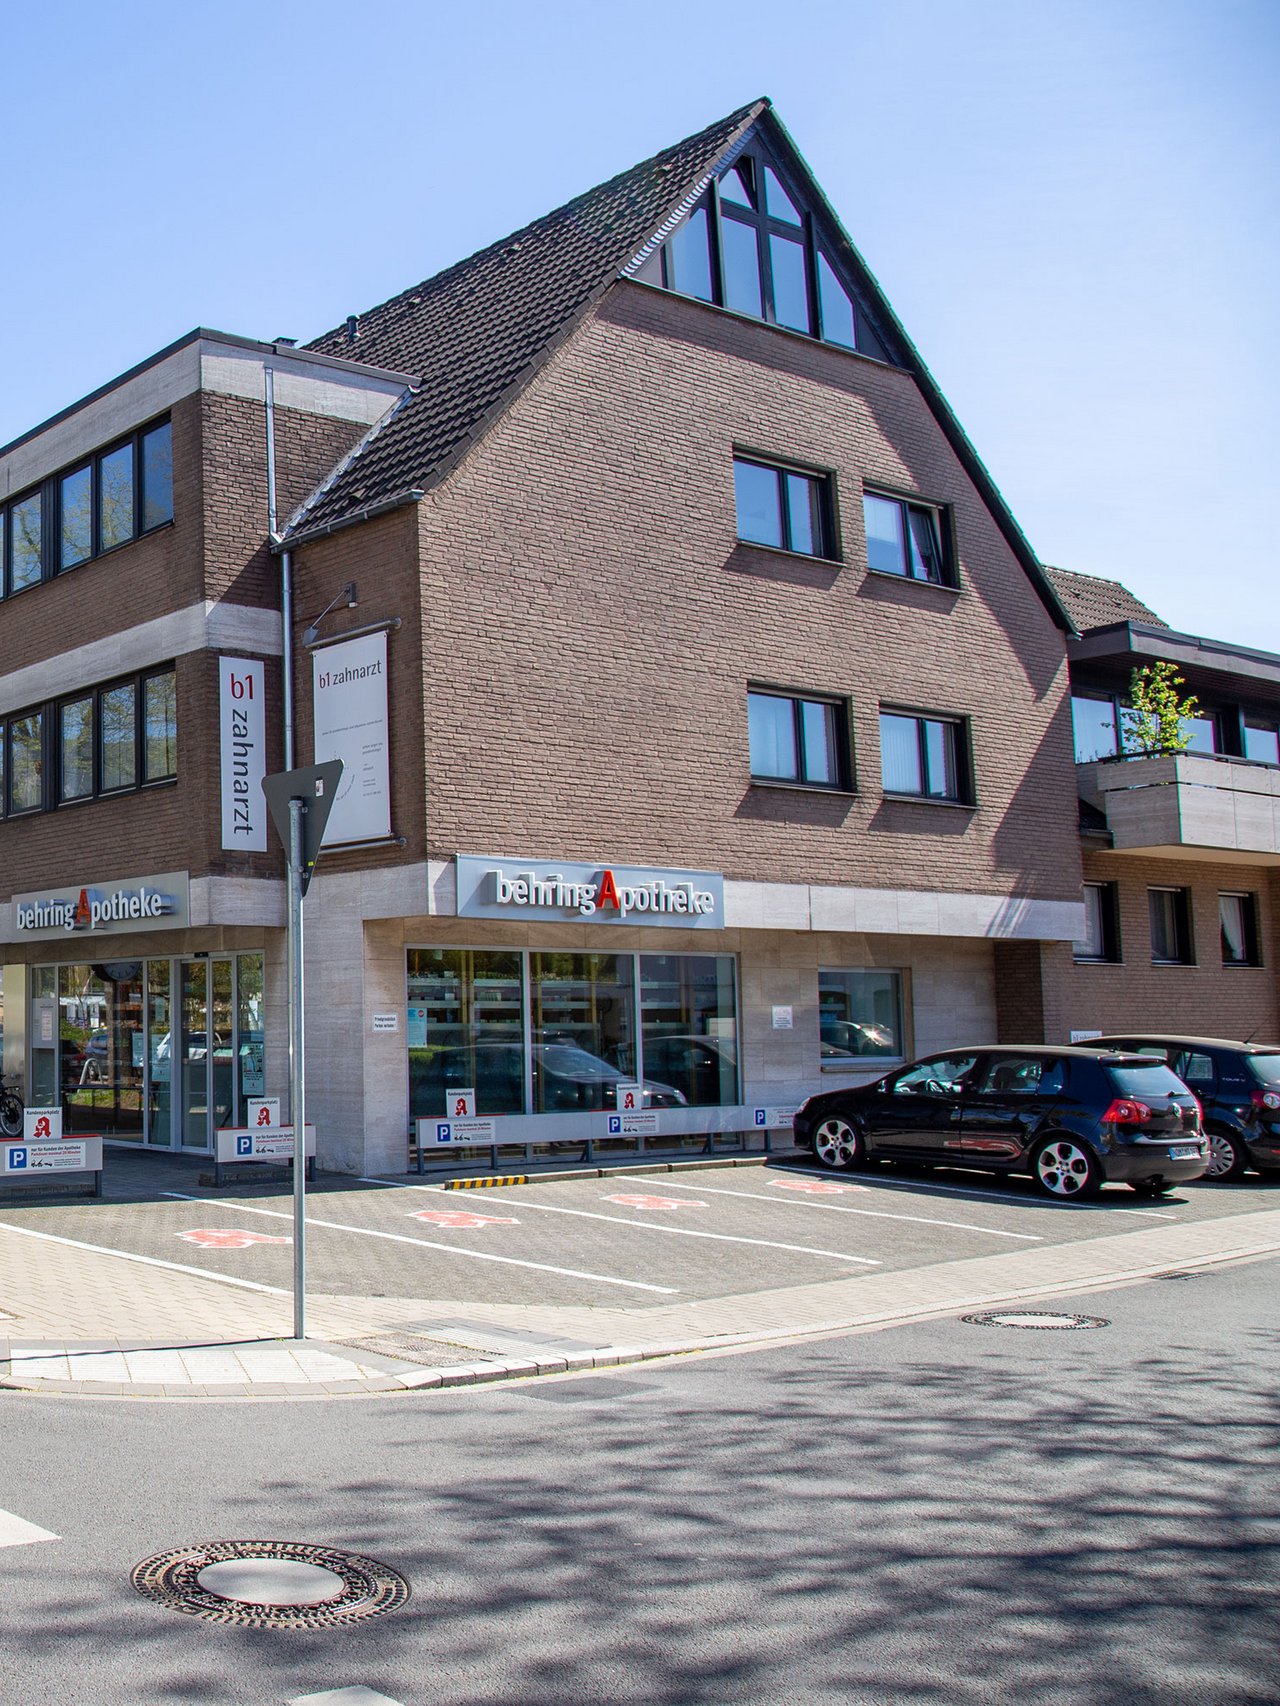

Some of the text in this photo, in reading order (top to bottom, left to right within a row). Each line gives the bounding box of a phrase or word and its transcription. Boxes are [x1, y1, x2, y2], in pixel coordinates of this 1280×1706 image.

[319, 660, 382, 689] b1 zahnarzt
[230, 672, 255, 836] b1 zahnarzt
[611, 1118, 619, 1131] P
[440, 1126, 448, 1140] P
[240, 1138, 250, 1153] P
[13, 1151, 25, 1167] P
